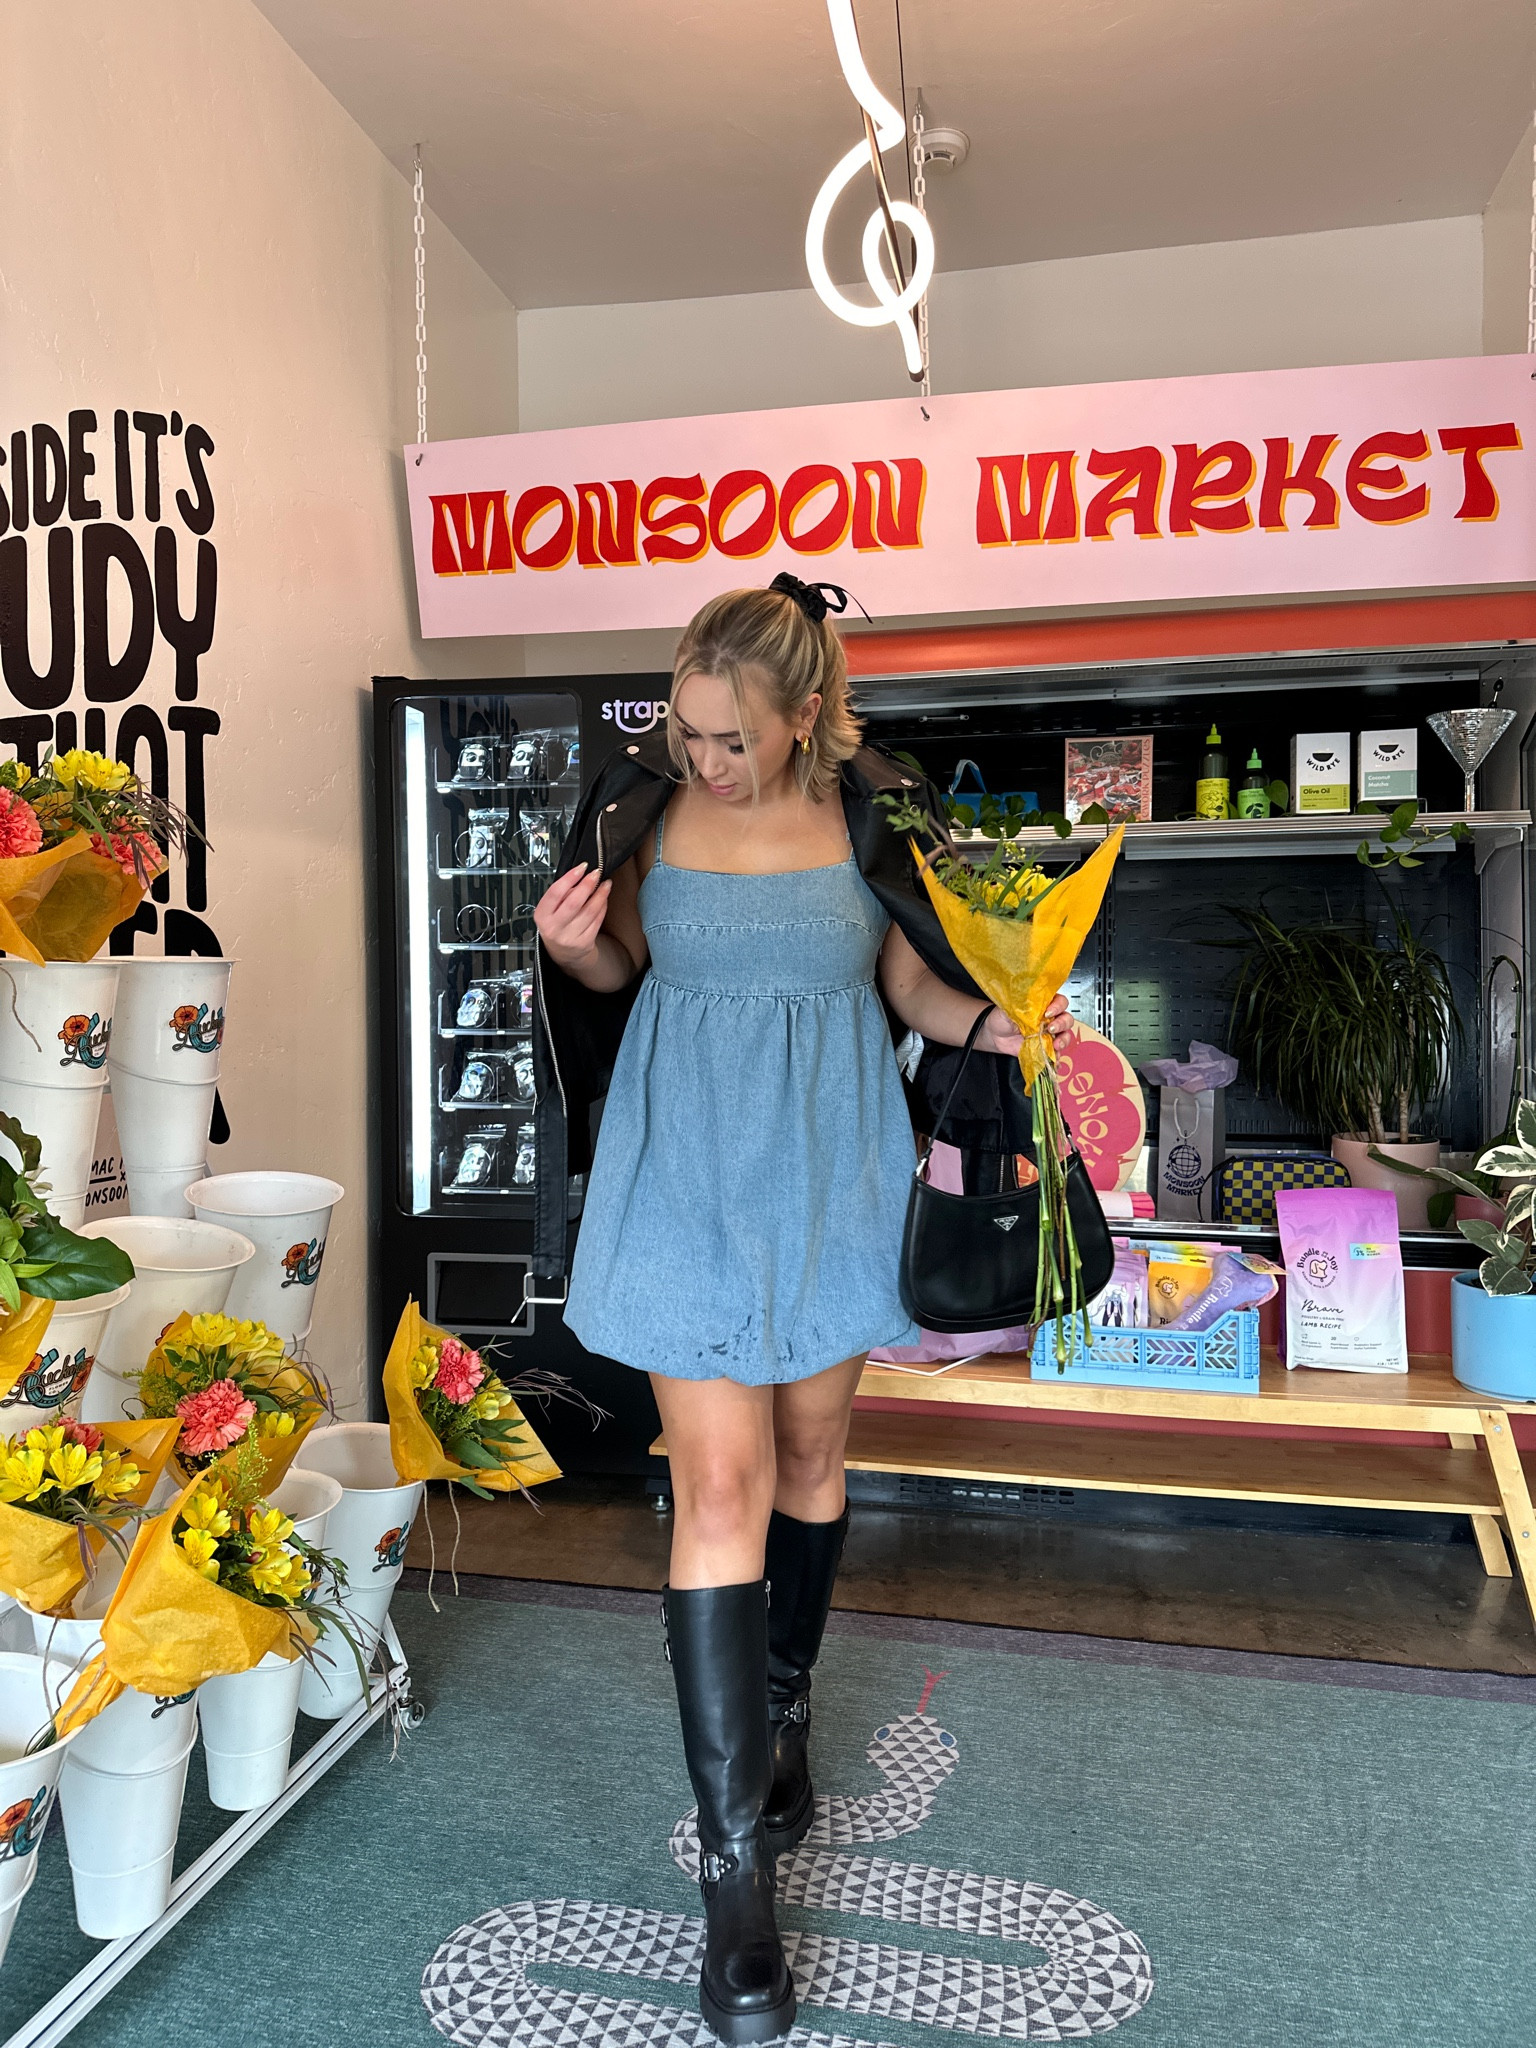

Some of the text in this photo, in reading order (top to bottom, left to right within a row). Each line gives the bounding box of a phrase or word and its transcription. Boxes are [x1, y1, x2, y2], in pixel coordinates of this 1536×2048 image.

[114, 409, 215, 535] IT'S
[428, 422, 1523, 577] MONSOON MARKET
[1373, 749, 1405, 762] WILD RYE
[1306, 757, 1341, 772] WILD RYE
[1163, 1171, 1205, 1188] MONSOON
[1297, 1247, 1321, 1269] Bundle
[1327, 1255, 1339, 1271] Joy
[1186, 1293, 1219, 1325] Bundle
[1301, 1299, 1344, 1314] Brave
[1319, 1322, 1342, 1330] RECIPE
